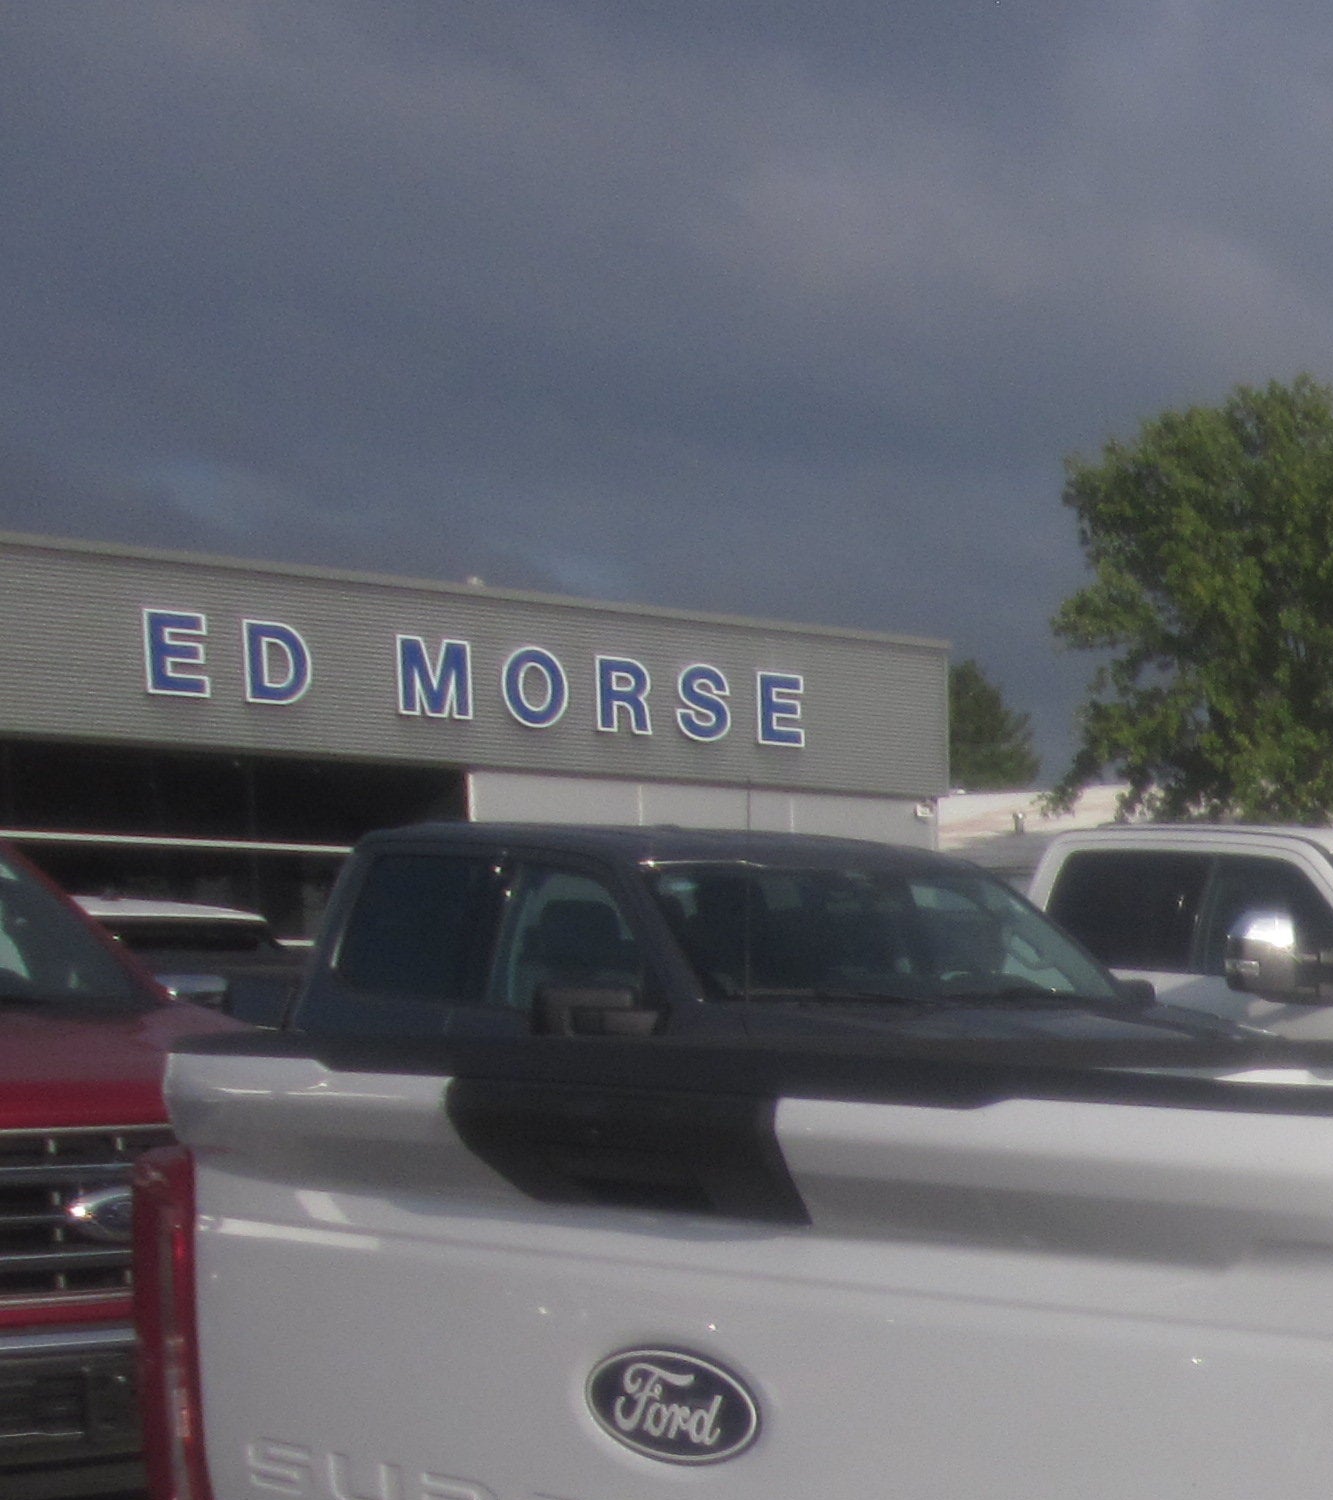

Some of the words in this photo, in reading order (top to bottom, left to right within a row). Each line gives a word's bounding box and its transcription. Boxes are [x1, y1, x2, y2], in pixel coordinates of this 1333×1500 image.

[142, 607, 314, 706] ED
[396, 633, 806, 748] MORSE
[612, 1361, 722, 1446] Ford
